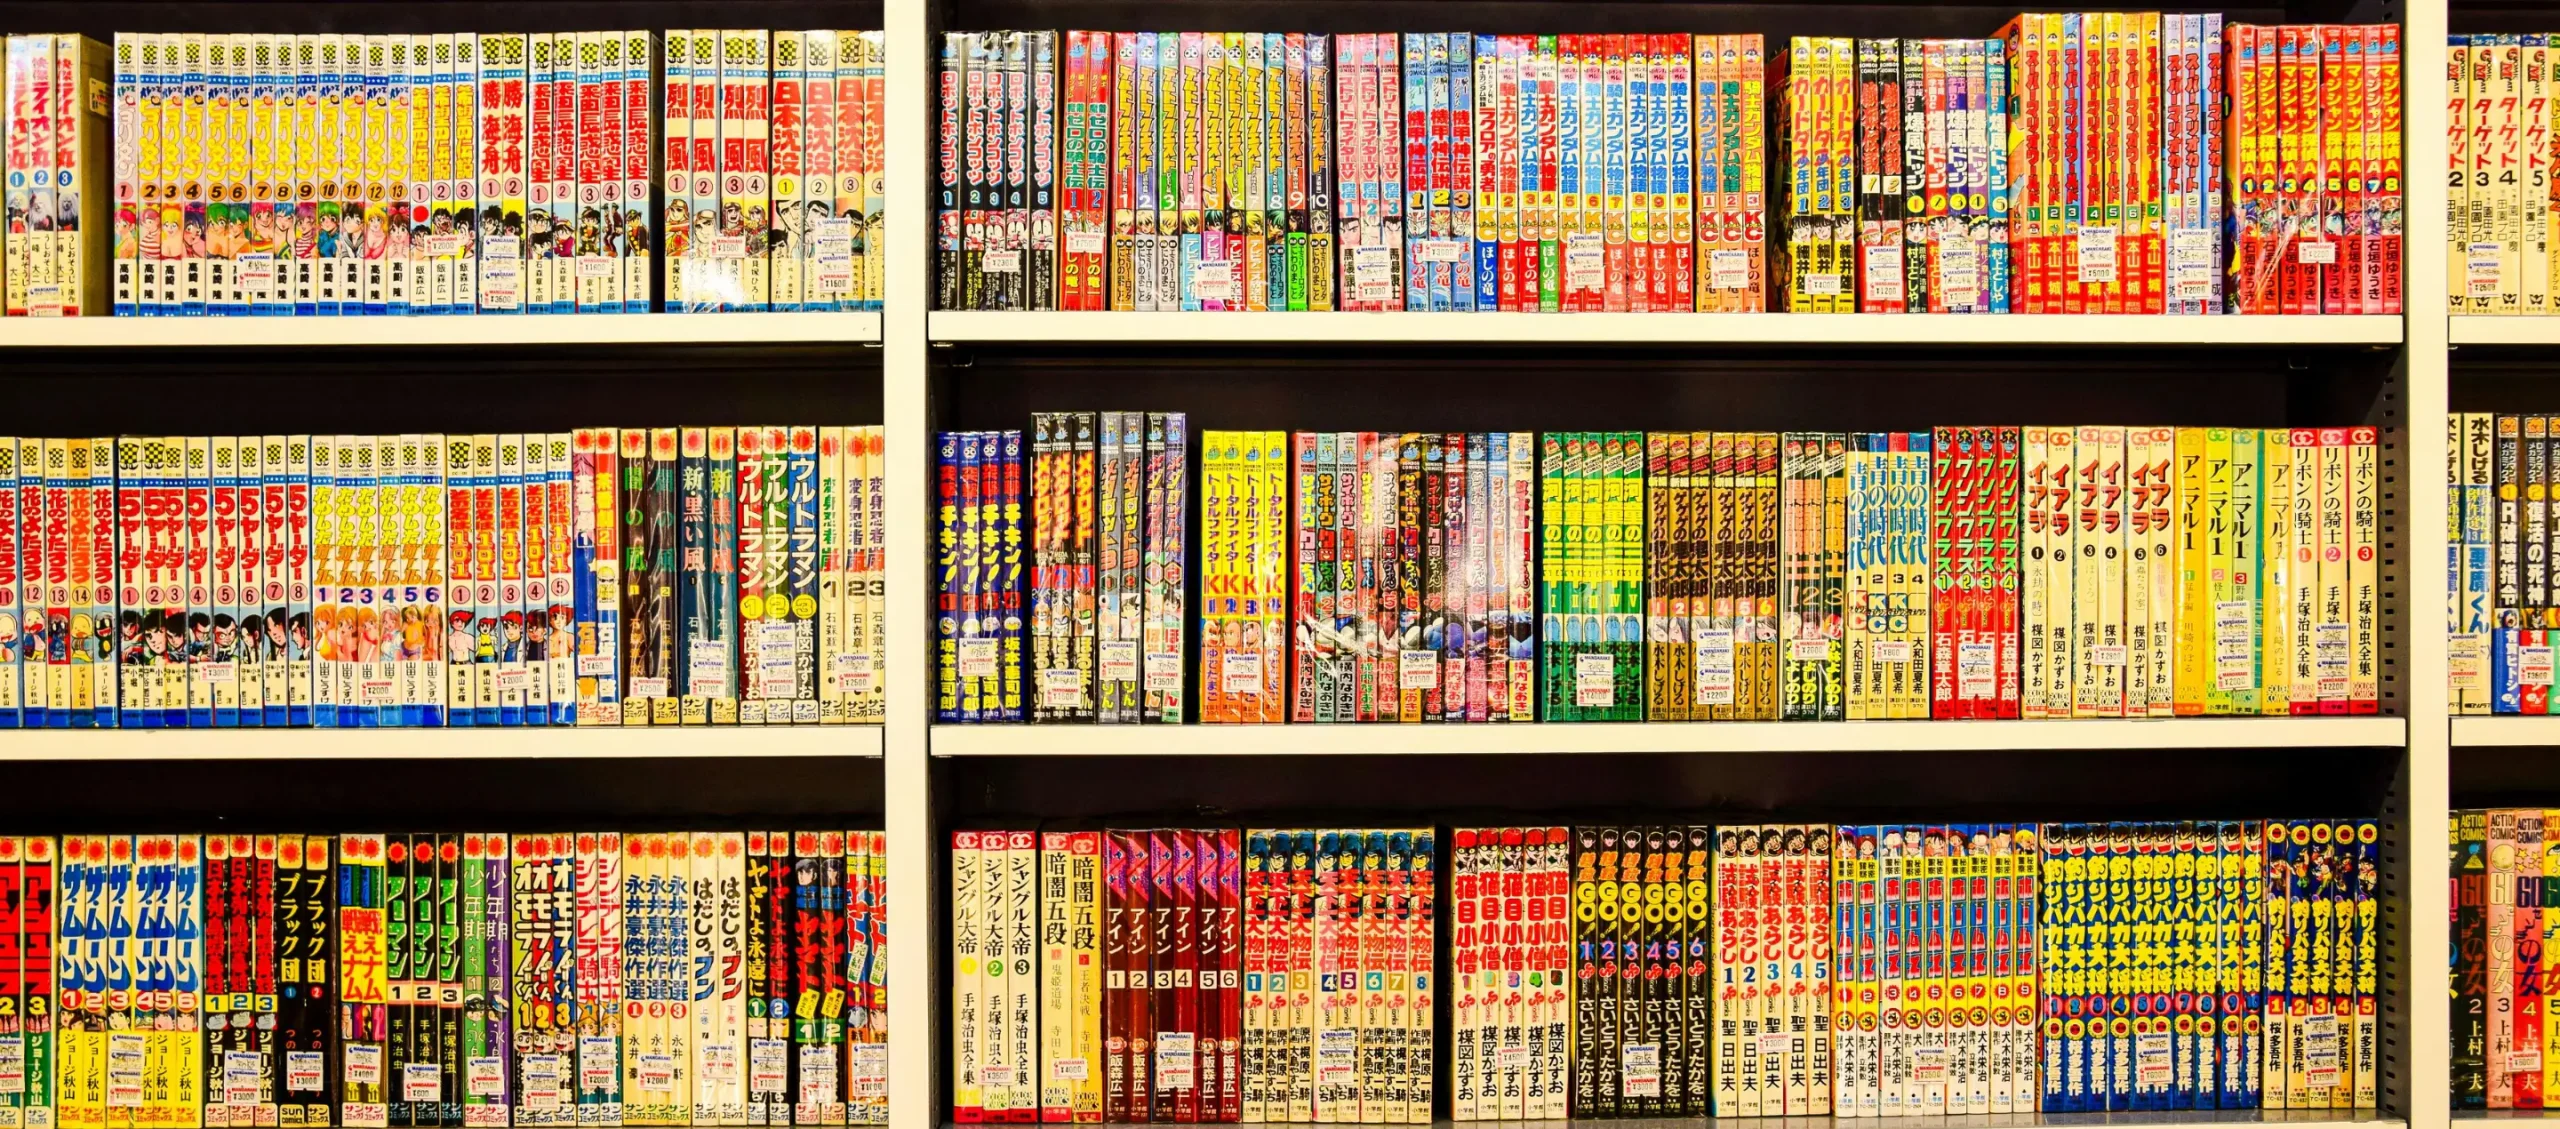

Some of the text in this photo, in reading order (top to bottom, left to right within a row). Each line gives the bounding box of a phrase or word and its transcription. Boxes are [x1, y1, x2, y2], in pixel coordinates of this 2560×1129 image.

[2474, 99, 2492, 169] ターゲット
[2498, 98, 2517, 168] ターゲット
[2499, 171, 2517, 185] 4
[2526, 98, 2546, 168] ターゲット
[2533, 171, 2543, 185] 5
[2476, 173, 2489, 187] 3
[2080, 460, 2098, 531] イアラ
[2295, 448, 2312, 545] リボンの騎士
[2323, 448, 2341, 545] リボンの騎士
[2356, 447, 2373, 544] リボンの騎士
[2471, 417, 2490, 484] 水木しげる
[739, 459, 762, 588] ウルトラマン
[764, 459, 788, 588] ウルトラマン
[792, 459, 816, 588] ウルトラマン
[1850, 462, 1866, 570] 青の時代
[1868, 456, 1888, 566] 青の時代
[1889, 456, 1908, 566] 青の時代
[2028, 462, 2047, 533] イアラ
[2051, 464, 2069, 536] イアラ
[2298, 587, 2310, 678] 手塚治虫全集
[2358, 585, 2372, 676] 手塚治虫全集
[2469, 547, 2490, 634] 悪魔くん
[280, 875, 301, 982] ブラック団
[306, 875, 326, 982] ブラック団
[625, 875, 646, 1001] 永井豪傑作選
[647, 875, 666, 1001] 永井豪傑作選
[668, 875, 688, 1002] 永井豪傑作選
[958, 856, 978, 954] ジャングル大帝
[984, 857, 1004, 957] ジャングル大帝
[1011, 856, 1032, 955] ジャングル大帝
[1045, 853, 1067, 946] 暗闇五段
[1073, 857, 1095, 950] 暗闇五段
[1107, 908, 1125, 954] アイン
[1130, 908, 1146, 954] アイン
[1157, 908, 1172, 954] アイン
[1455, 874, 1477, 974] 猫目小僧
[1479, 872, 1500, 972] 猫目小僧
[1502, 872, 1524, 972] 猫目小僧
[1724, 968, 1733, 983] 1
[1743, 968, 1756, 983] 2
[1768, 965, 1779, 980] 3
[1791, 964, 1803, 980] 4
[1814, 962, 1827, 979] 5
[961, 993, 975, 1086] 手塚治虫全集
[1015, 994, 1028, 1086] 手塚治虫全集
